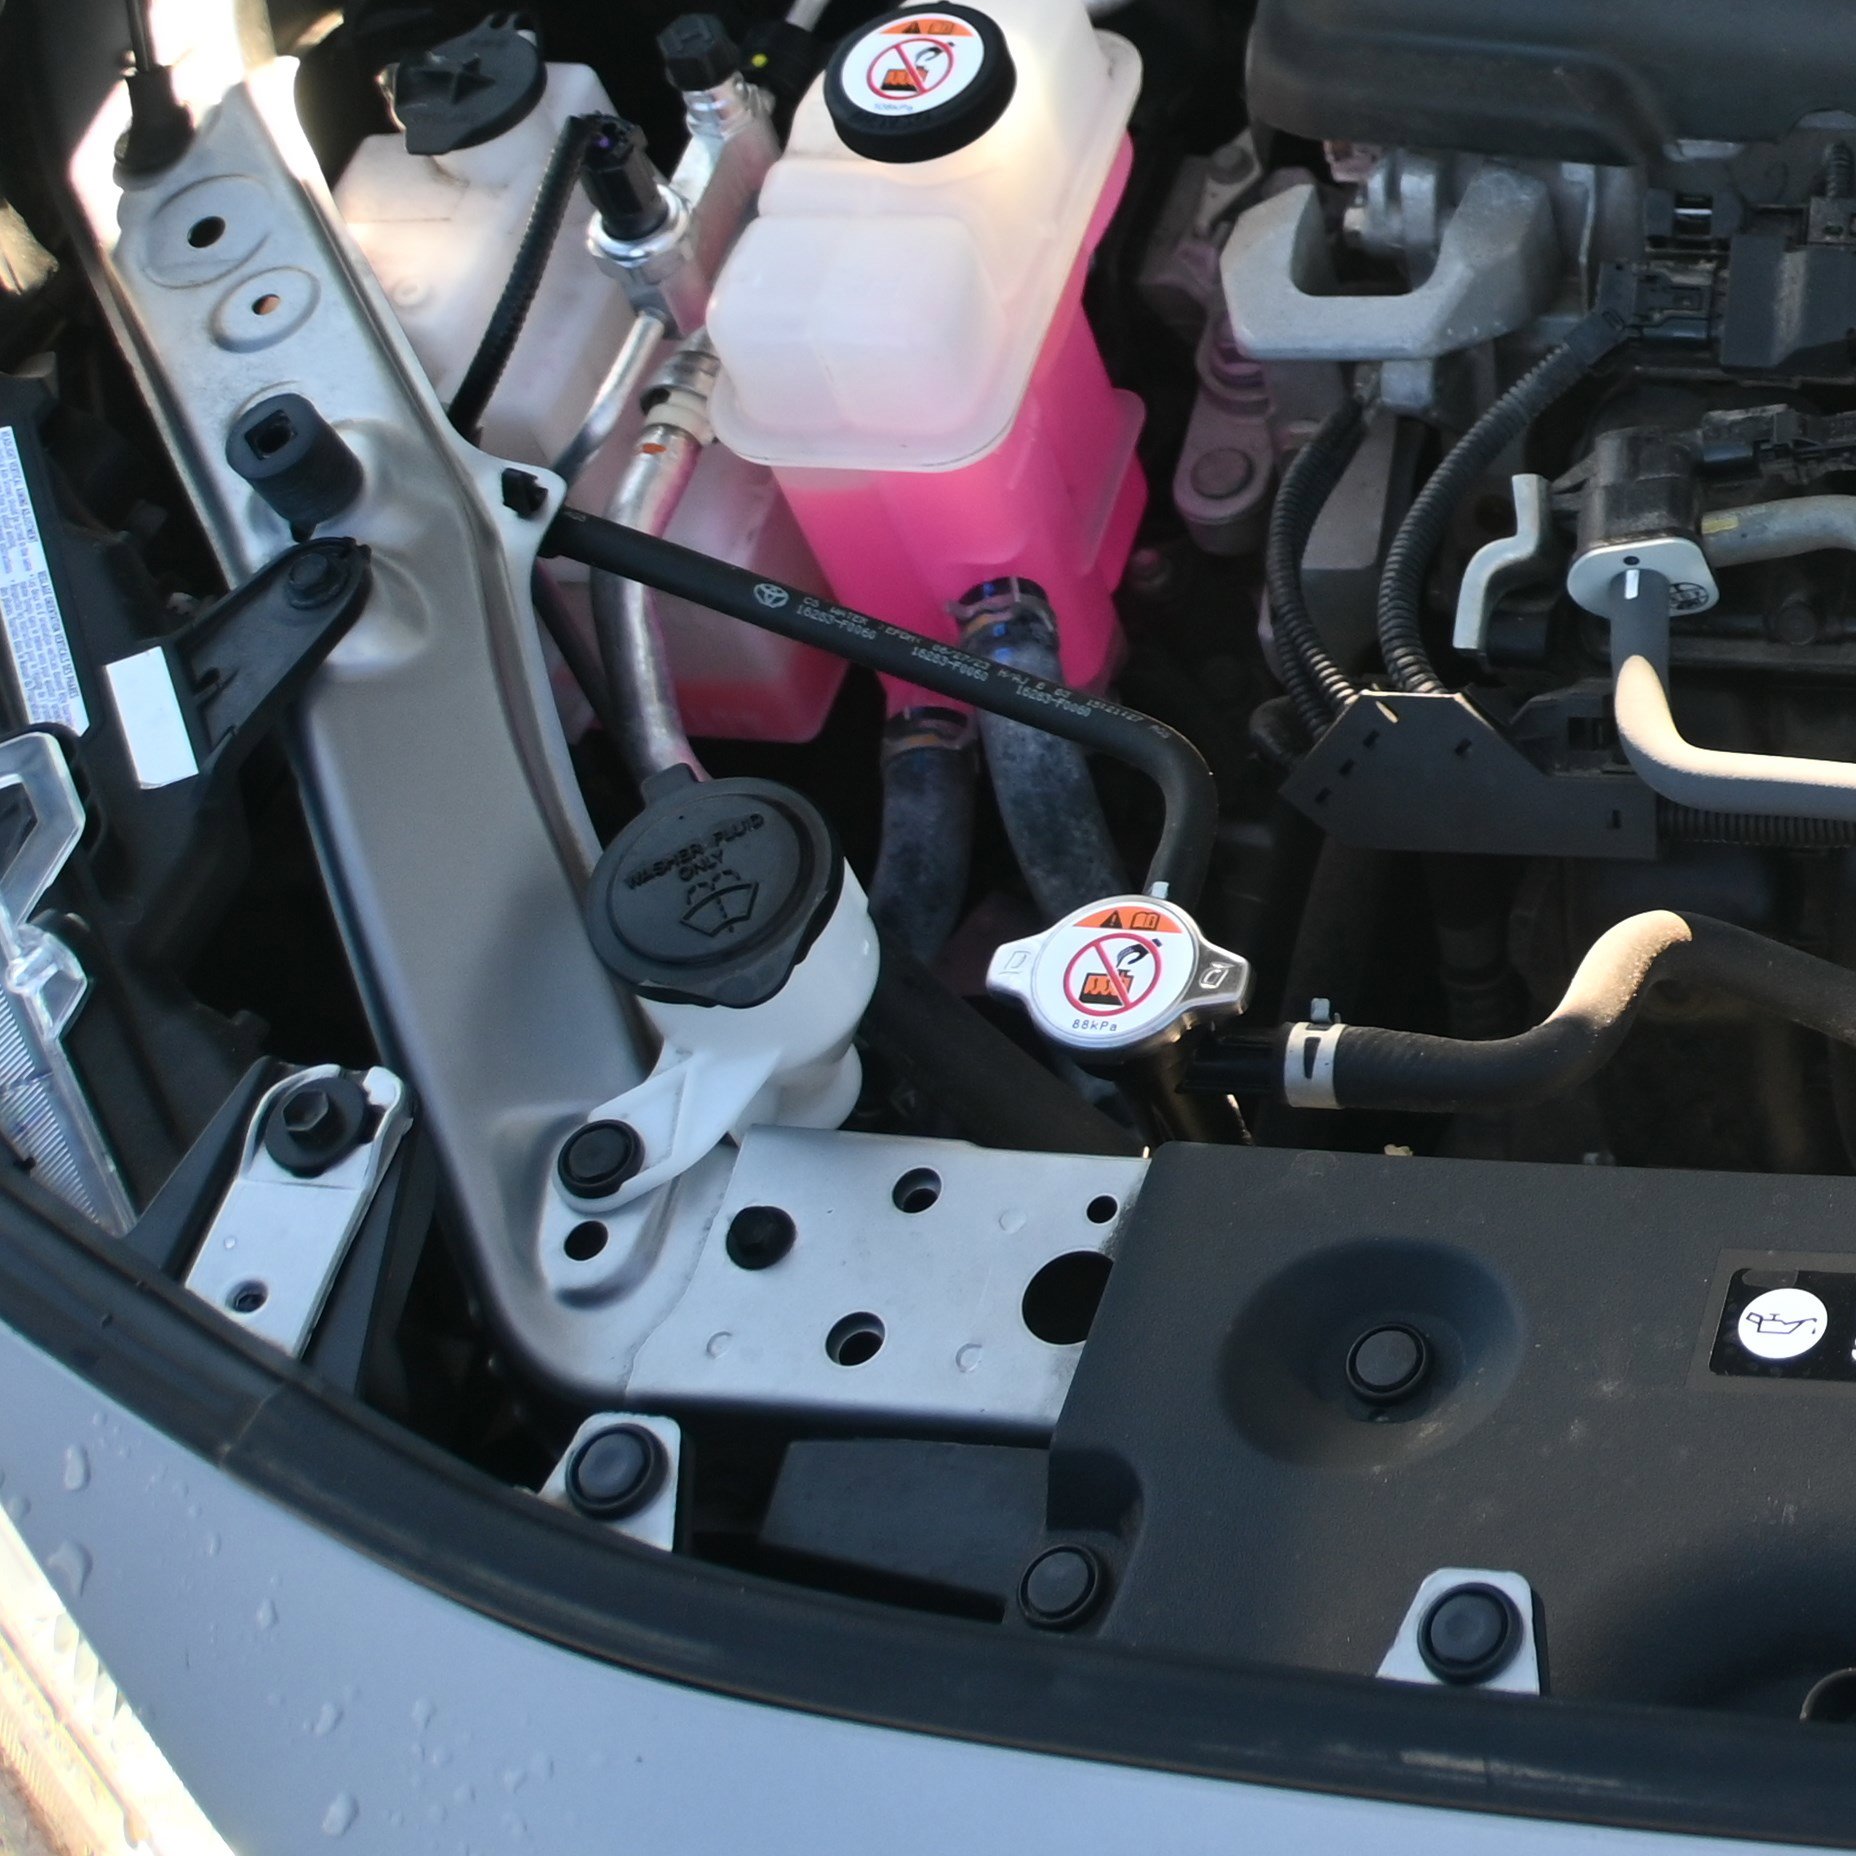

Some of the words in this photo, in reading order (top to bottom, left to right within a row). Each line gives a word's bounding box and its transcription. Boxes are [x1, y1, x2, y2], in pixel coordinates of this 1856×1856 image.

[625, 842, 705, 890] WASHER
[713, 813, 765, 849] FLUID
[679, 848, 725, 882] ONLY
[1072, 1018, 1118, 1032] 88kPa
